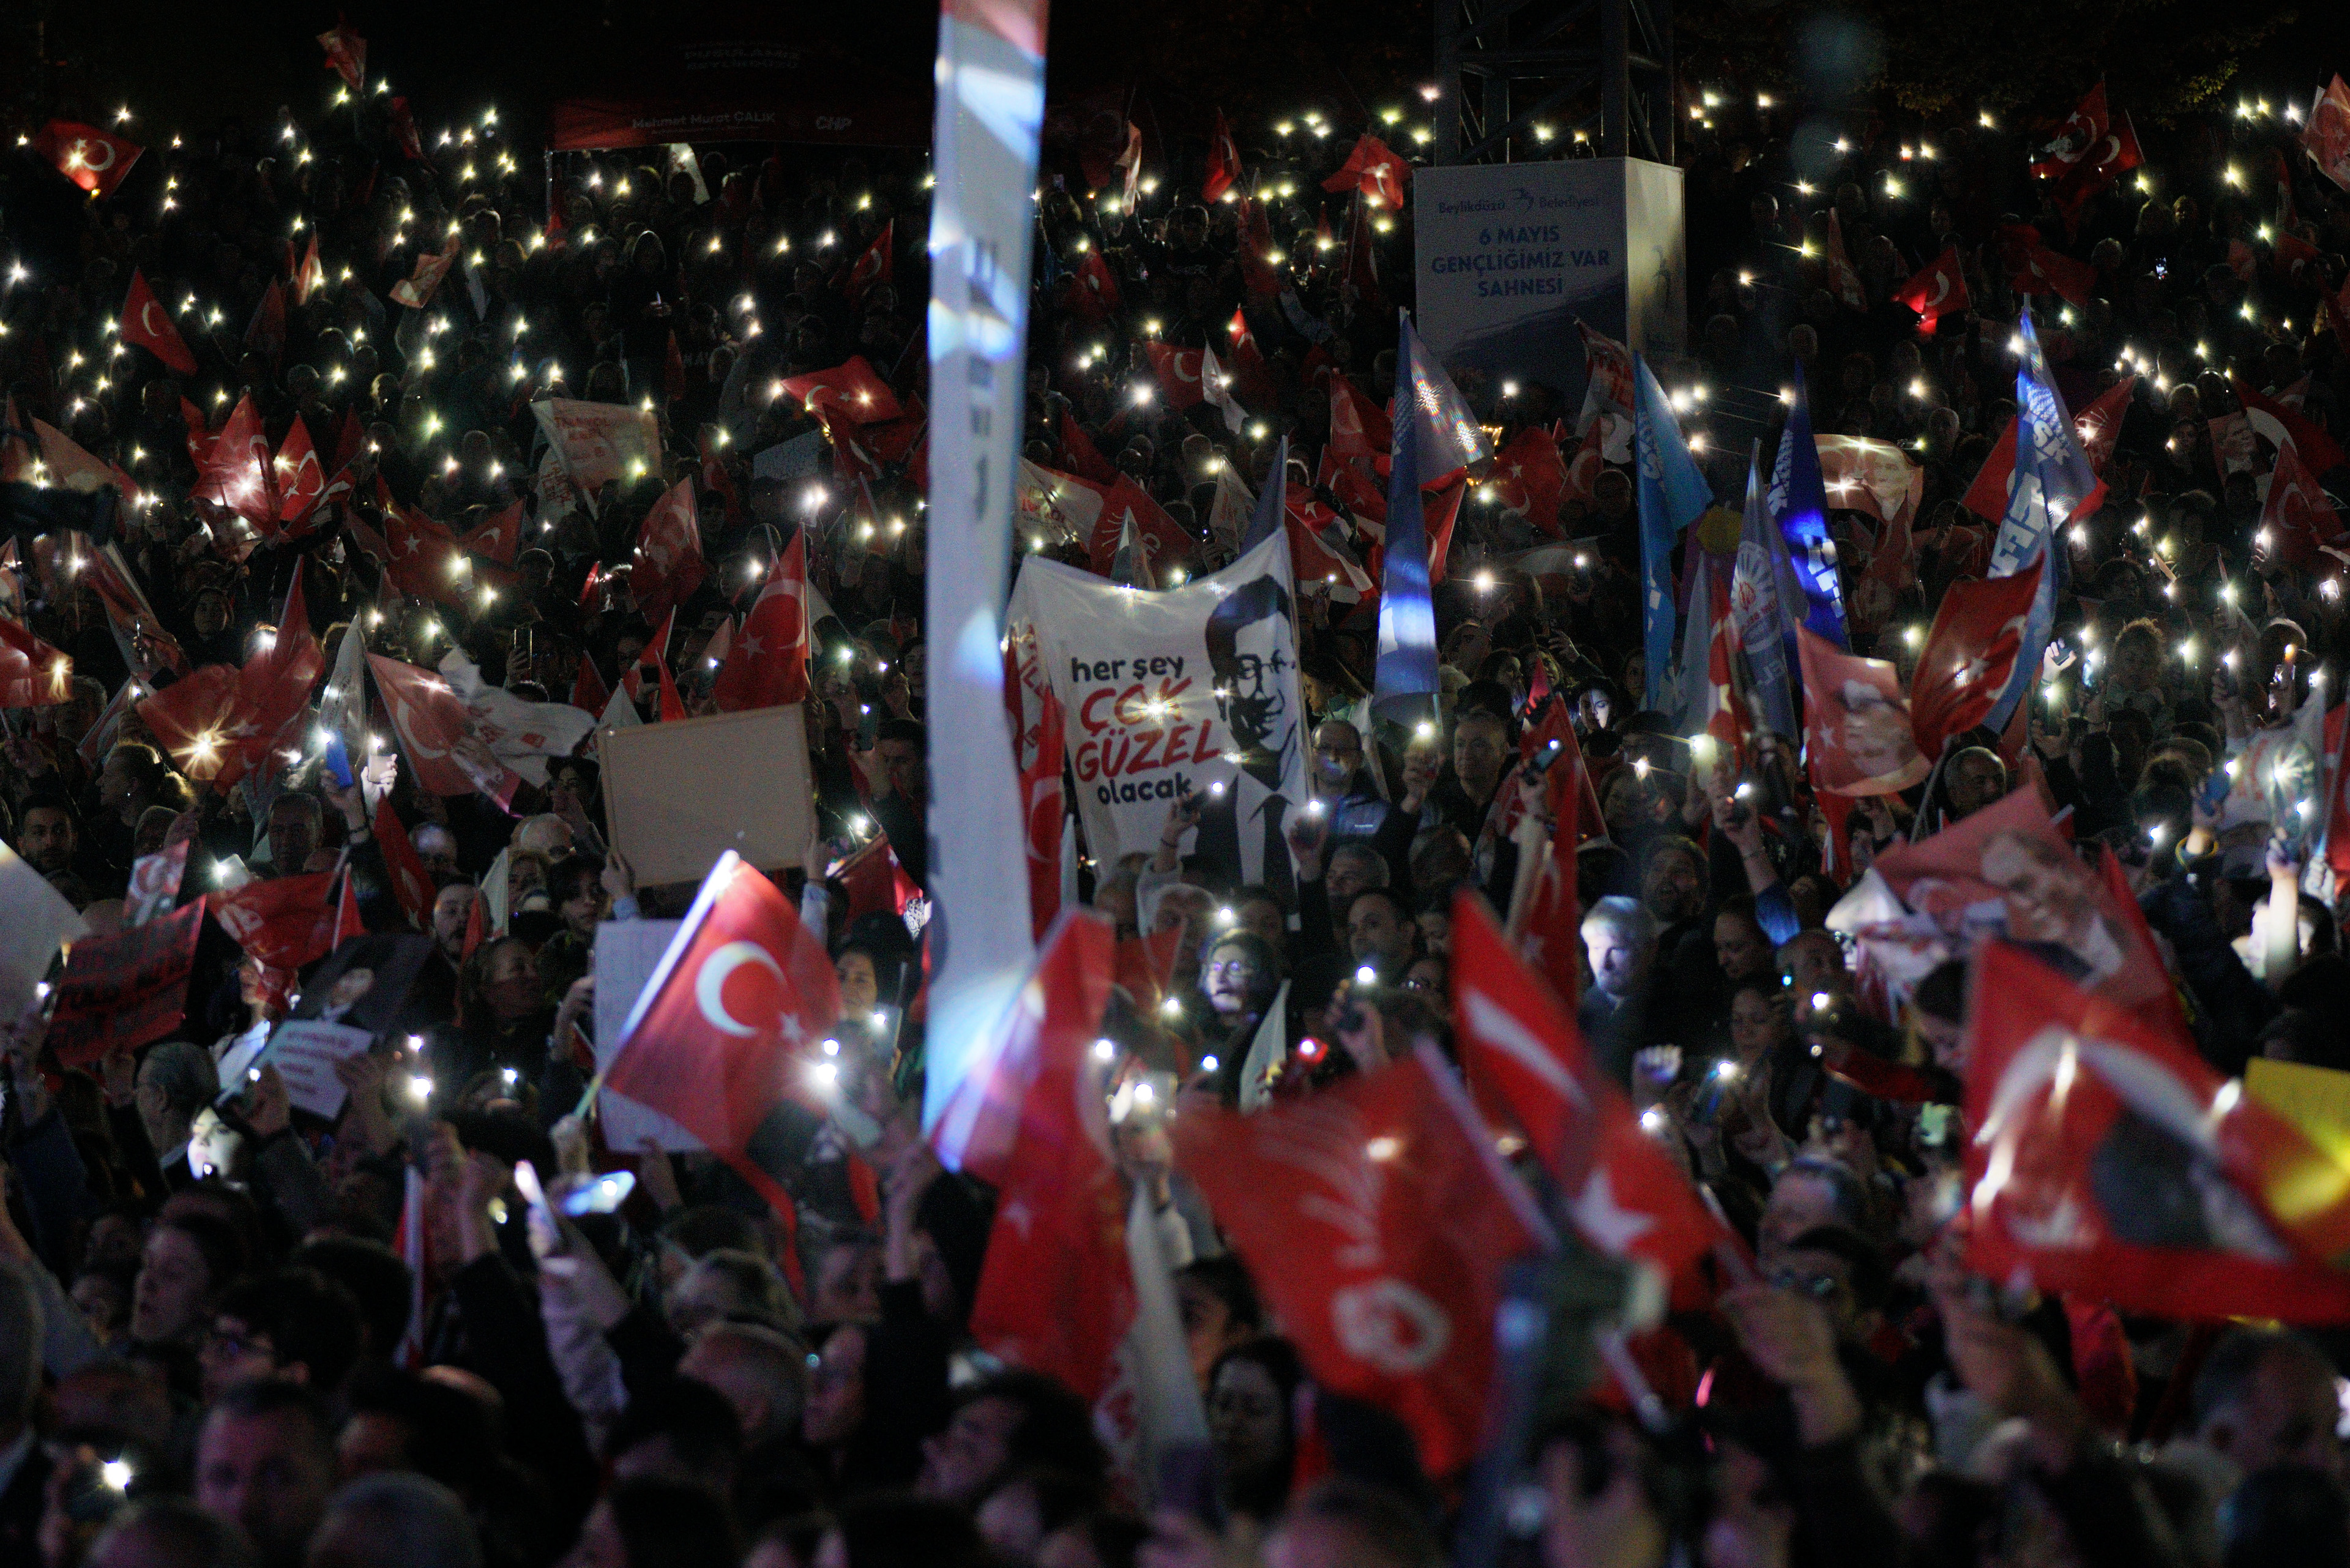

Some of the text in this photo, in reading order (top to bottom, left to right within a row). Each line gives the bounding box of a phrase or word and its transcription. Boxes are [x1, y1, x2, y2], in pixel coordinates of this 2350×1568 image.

[632, 116, 686, 129] Mehmet
[691, 113, 730, 125] Murat
[815, 116, 853, 130] CHP
[1439, 195, 1600, 214] Beylikdüzü Belediyesi
[1479, 225, 1560, 245] 6 MAYIS
[1431, 247, 1610, 277] GENÇLİĞİMİZ VAR
[1477, 273, 1563, 298] SAHNESİ
[1071, 656, 1184, 682] her şey
[1080, 677, 1193, 737] ÇOK
[1075, 719, 1221, 782] GÜZEL
[1097, 772, 1193, 805] olacak
